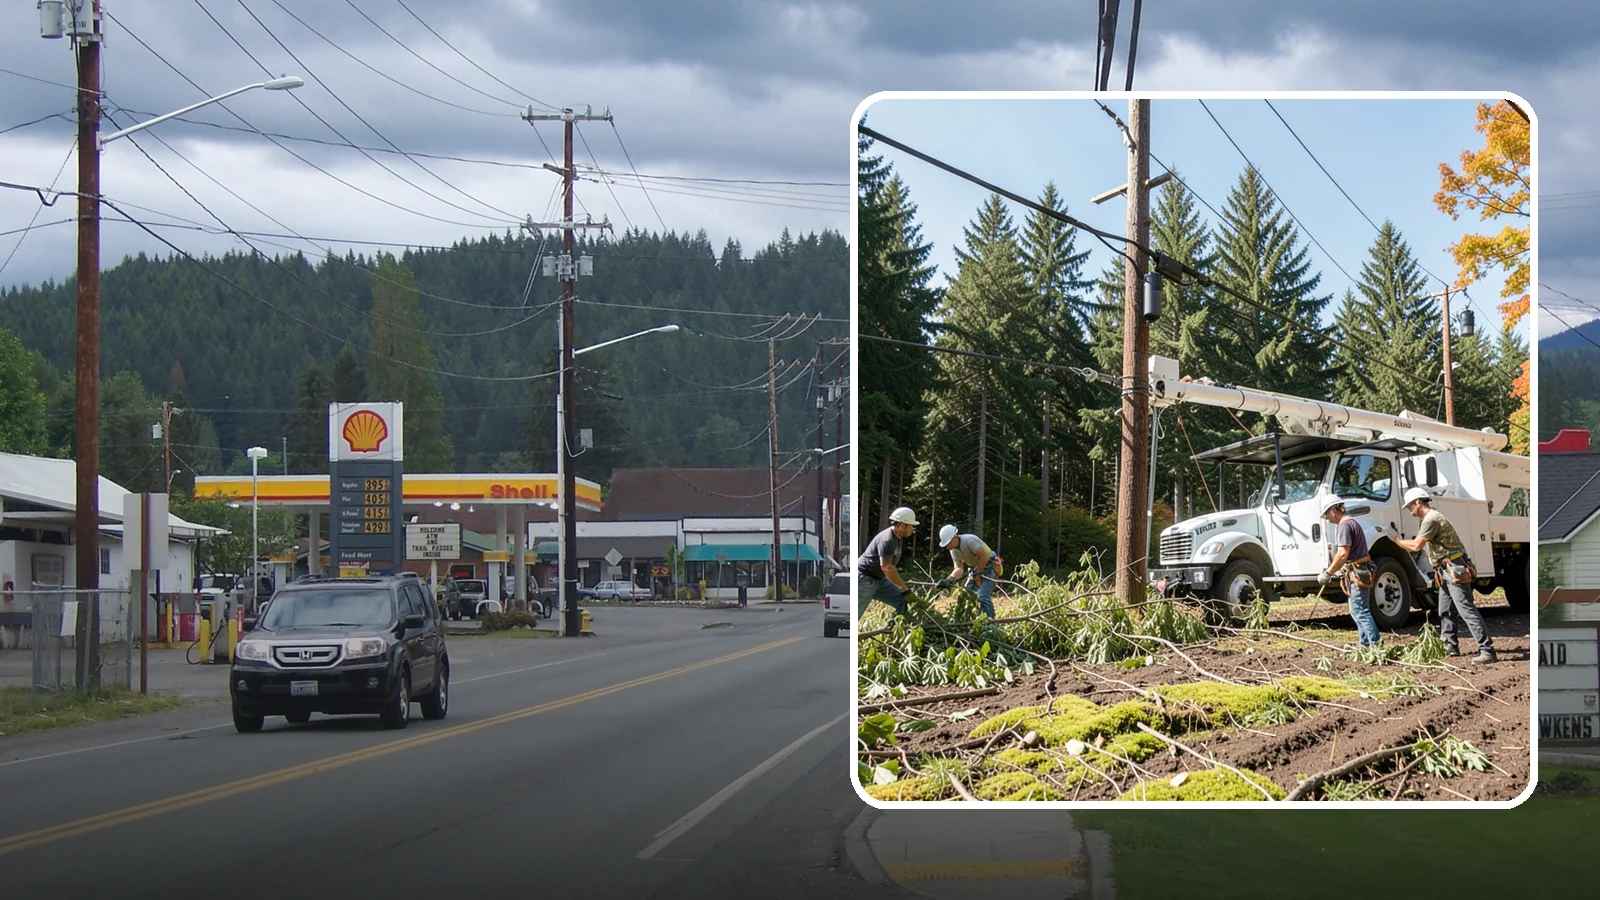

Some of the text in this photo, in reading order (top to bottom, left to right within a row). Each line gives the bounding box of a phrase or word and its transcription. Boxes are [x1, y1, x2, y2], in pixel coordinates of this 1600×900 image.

[366, 480, 383, 490] 395
[490, 484, 547, 499] Shell
[366, 494, 383, 504] 405
[366, 508, 383, 518] 415
[366, 522, 383, 533] 429
